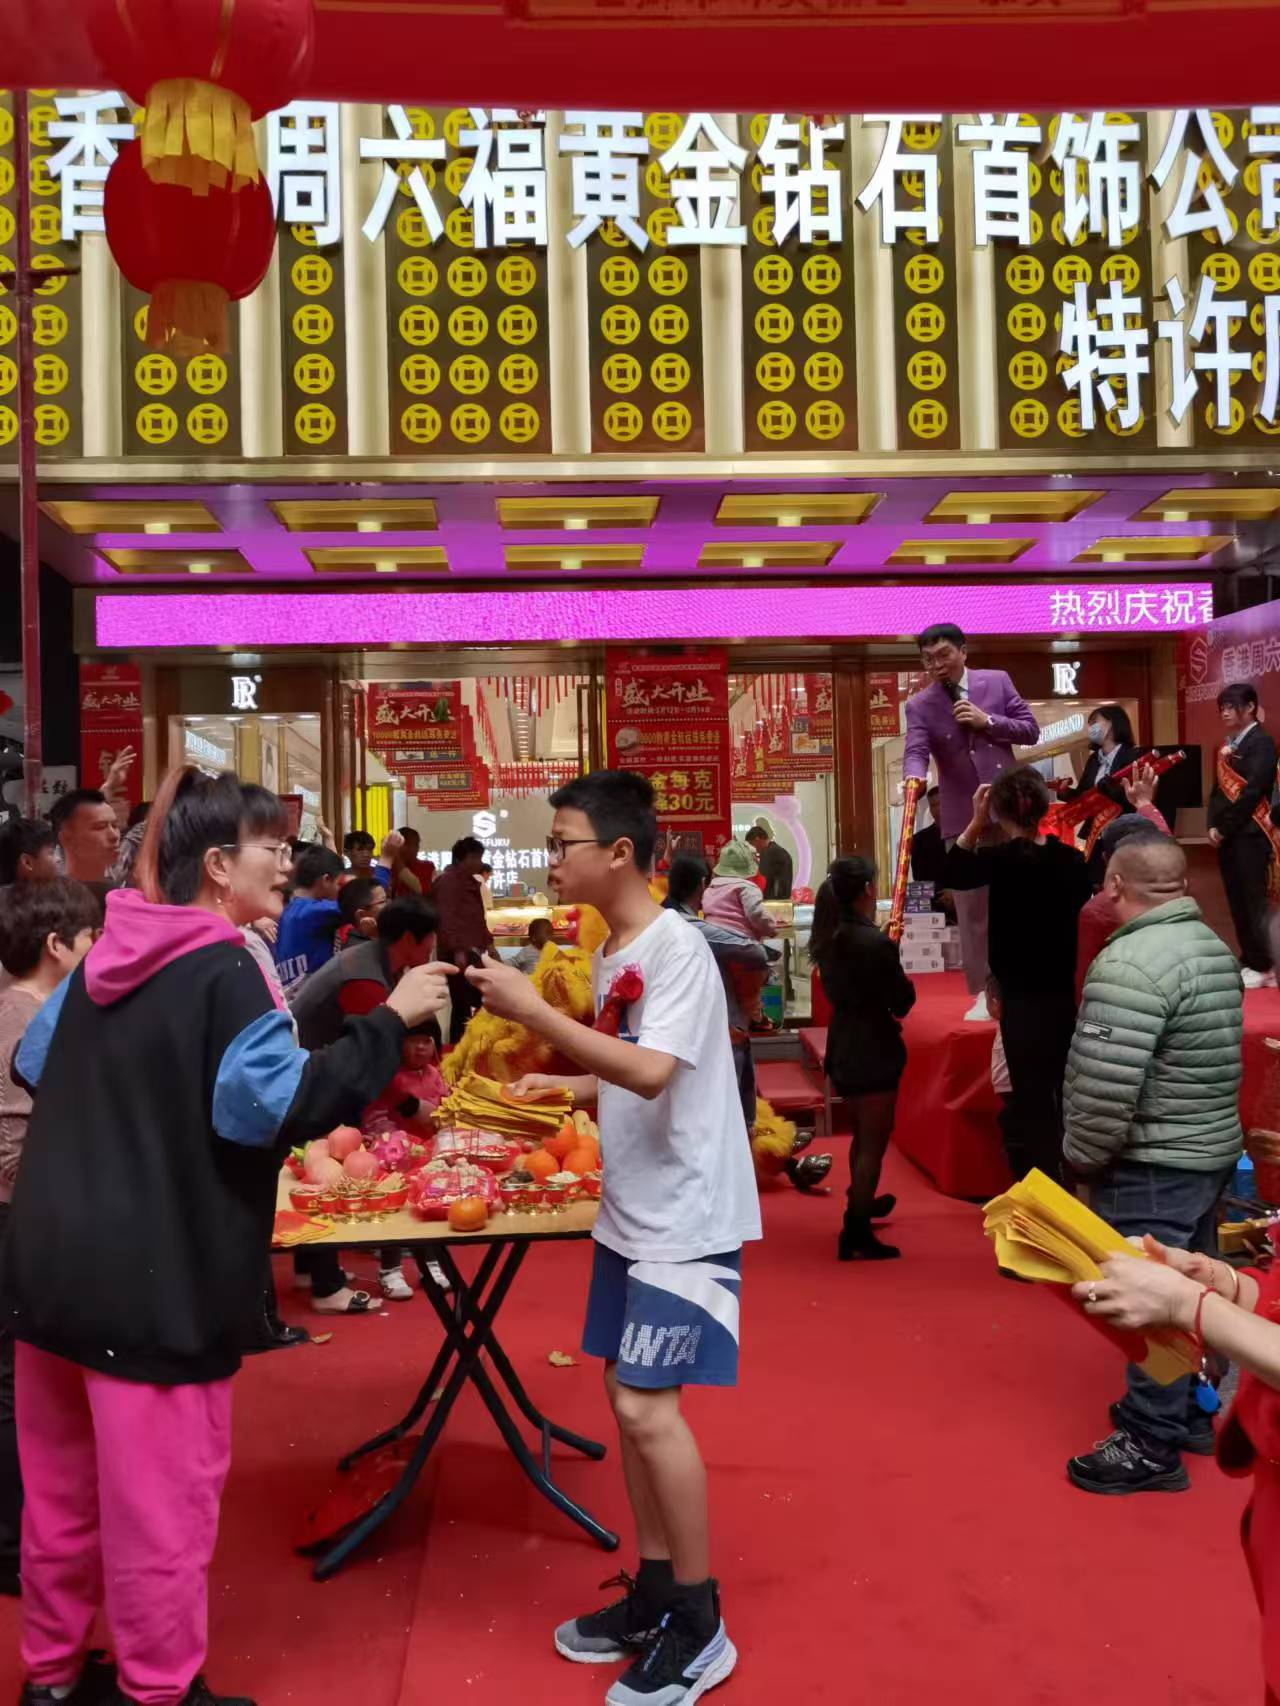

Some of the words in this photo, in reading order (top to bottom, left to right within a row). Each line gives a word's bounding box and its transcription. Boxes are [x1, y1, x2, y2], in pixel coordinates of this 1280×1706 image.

[45, 90, 1280, 254] 香周六福黄金钻石首饰公
[1057, 273, 1280, 431] 特许
[375, 697, 455, 725] 盛大开
[628, 769, 713, 791] 金每克
[485, 869, 519, 890] 许店
